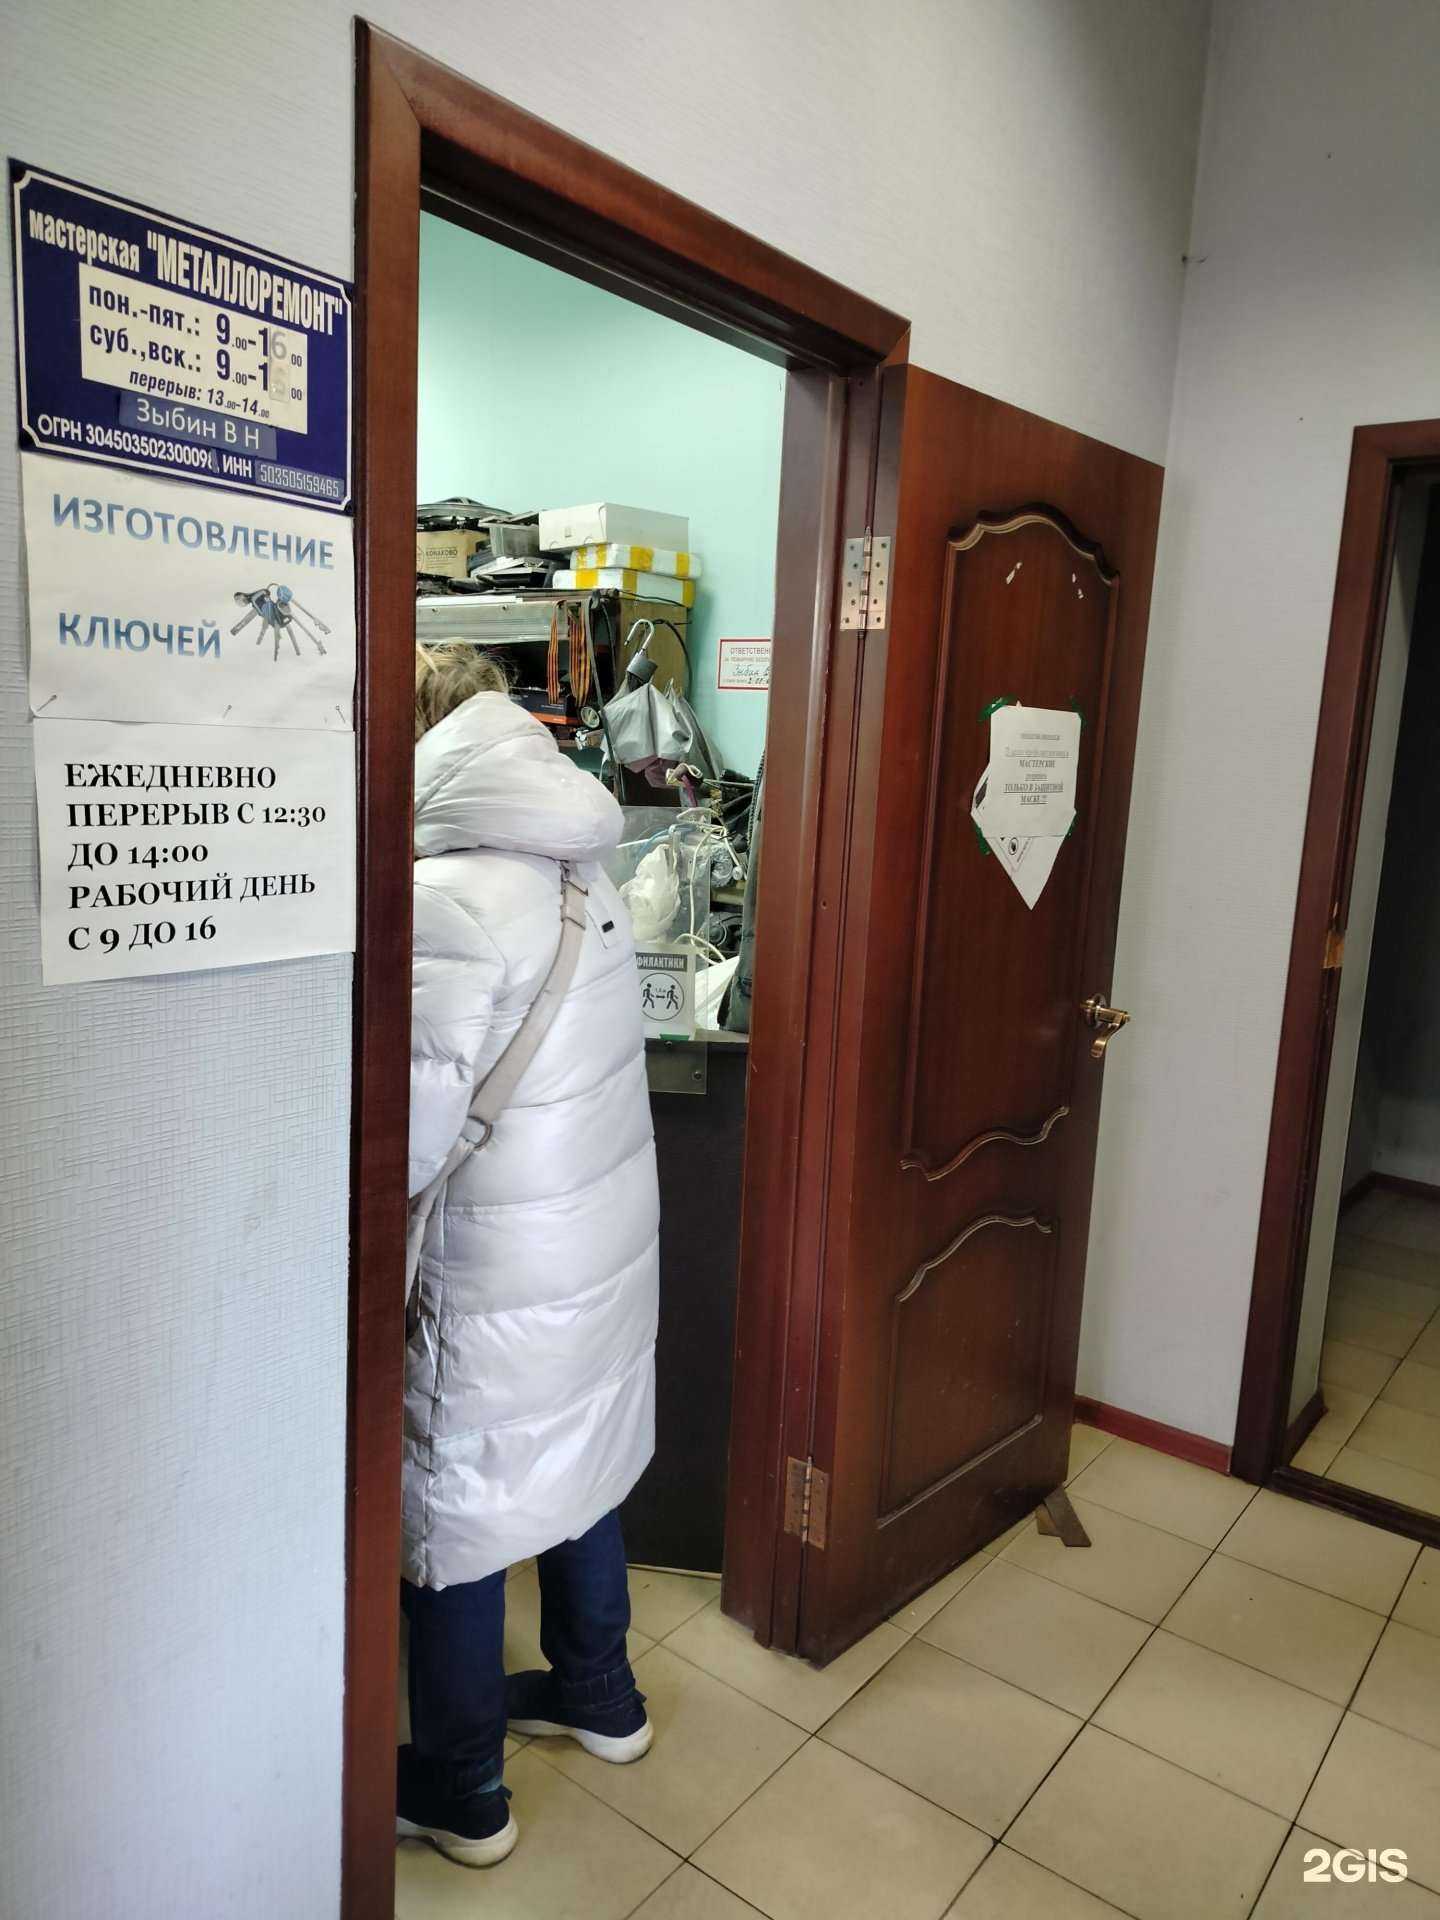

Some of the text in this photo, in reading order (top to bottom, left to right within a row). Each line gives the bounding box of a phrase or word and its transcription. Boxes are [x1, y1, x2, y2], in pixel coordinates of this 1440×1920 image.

[29, 209, 343, 335] мастерская "МЕТАЛЛОРЕМОНТ"
[128, 370, 270, 418] перерыв: 13.00-14.00
[136, 397, 259, 450] Зыбин В Н
[37, 414, 82, 443] ОГРН
[222, 453, 252, 479] ИНН
[260, 464, 339, 498] 503505159465
[53, 493, 335, 570] ИЗГОТОВЛЕНИЕ
[58, 611, 222, 660] КЛЮЧЕЙ
[64, 763, 276, 792] ЕЖЕДНЕВНО
[66, 802, 326, 828] ПЕРЕРЫВ С 12:30
[67, 841, 209, 872] ДО 14:00
[68, 872, 316, 910] РАБОЧИЙ ДЕНЬ
[68, 915, 217, 954] С 9 ДО 16
